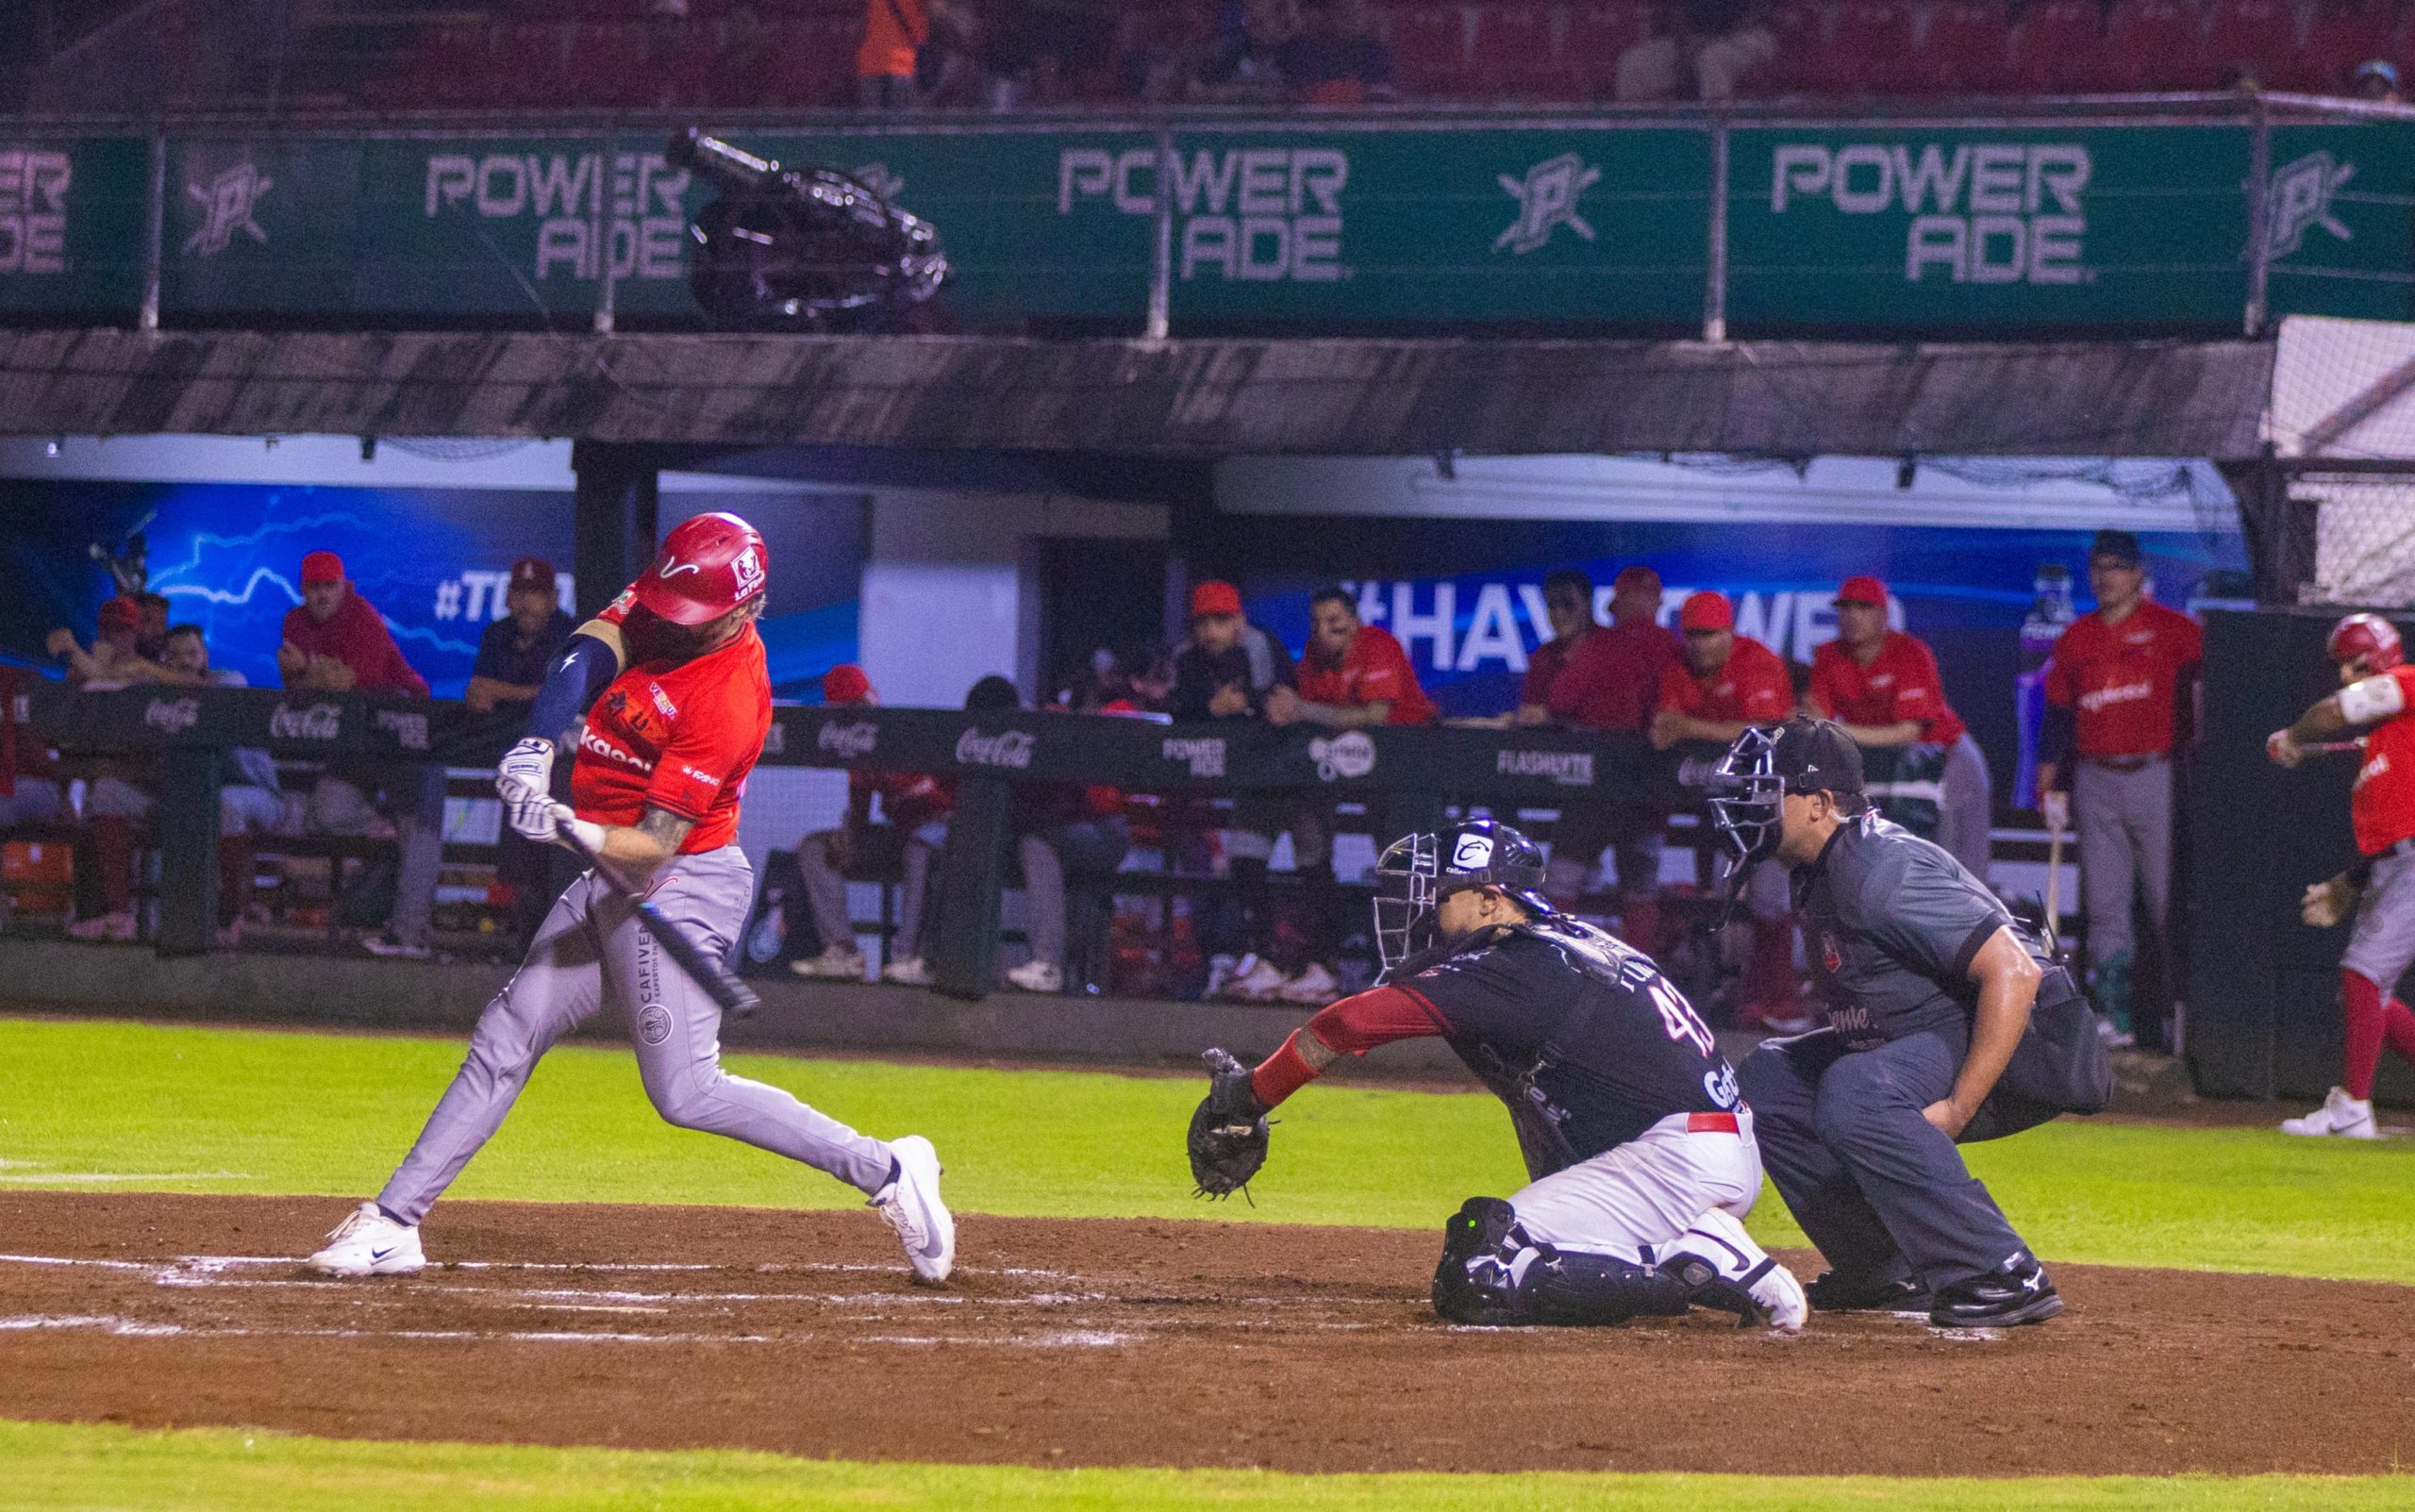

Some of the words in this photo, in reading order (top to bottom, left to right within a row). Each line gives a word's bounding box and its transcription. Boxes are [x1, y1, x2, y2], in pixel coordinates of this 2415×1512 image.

[425, 152, 691, 218] POWER
[1058, 148, 1348, 214] POWER
[1770, 143, 2092, 213] POWER
[536, 217, 685, 280] ADE
[1179, 214, 1343, 282] ADE
[1906, 215, 2087, 283] ADE
